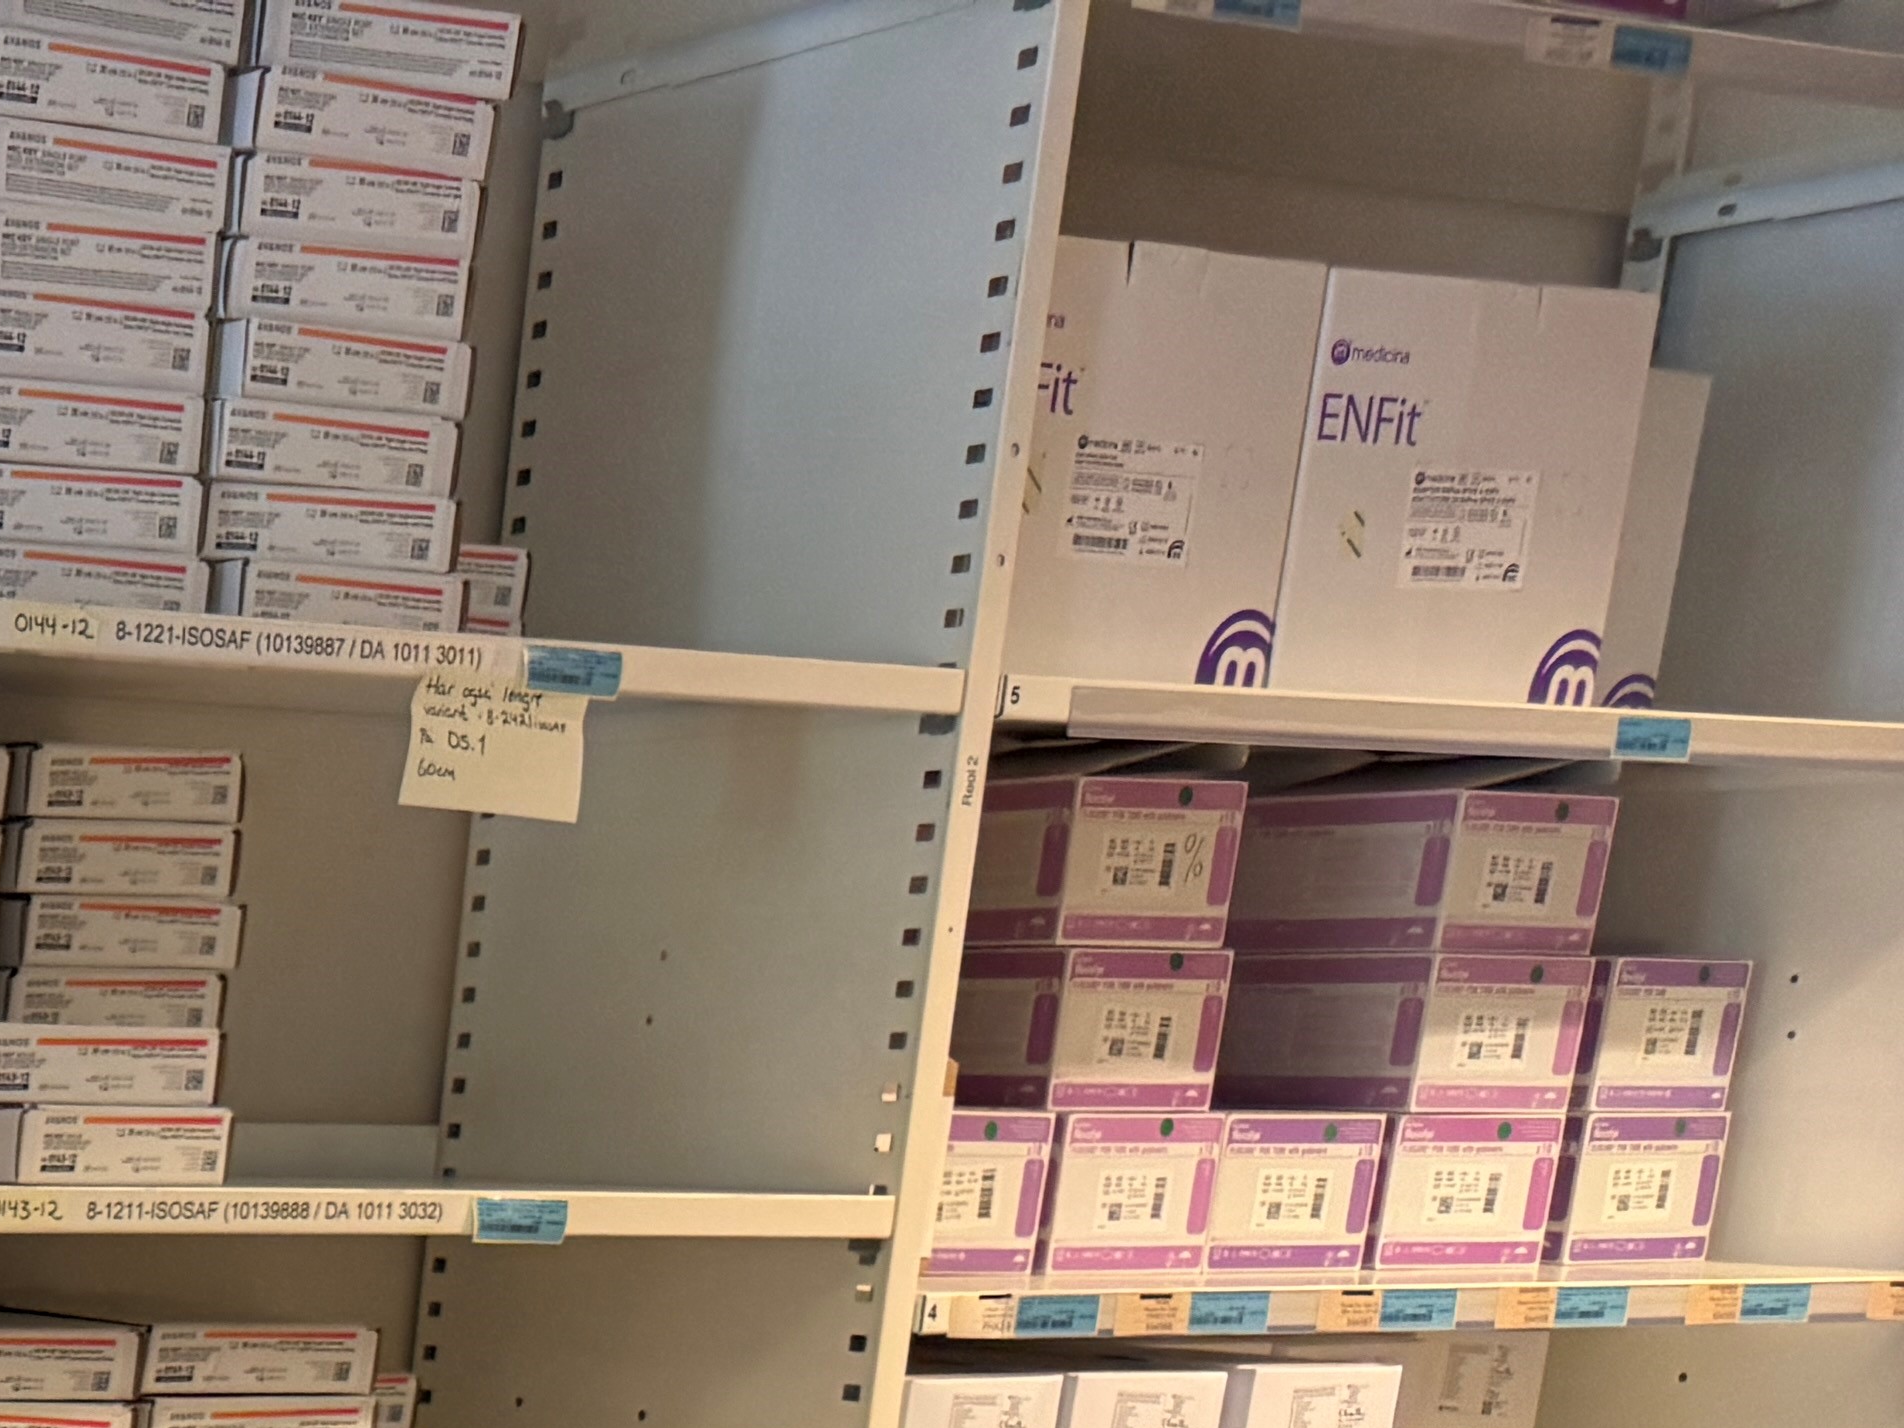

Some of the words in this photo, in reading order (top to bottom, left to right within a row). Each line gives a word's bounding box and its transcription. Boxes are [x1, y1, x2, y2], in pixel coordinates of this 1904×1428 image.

[1352, 343, 1410, 365] medicina
[1317, 393, 1422, 447] ENFit
[116, 620, 251, 650] 8-1221-ISOSAF
[256, 631, 344, 657] (10139887
[349, 637, 356, 658] /
[361, 639, 385, 660] DA
[392, 642, 430, 664] 1011
[436, 645, 482, 671] 3011)
[1010, 686, 1021, 706] 5
[87, 1201, 217, 1220] 8-1211-ISOSAF
[224, 1200, 309, 1223] (10139888
[314, 1202, 320, 1220] /
[325, 1203, 349, 1220] DA
[357, 1203, 392, 1220] 1011
[399, 1202, 442, 1223] 3032)
[928, 1303, 938, 1321] 4
